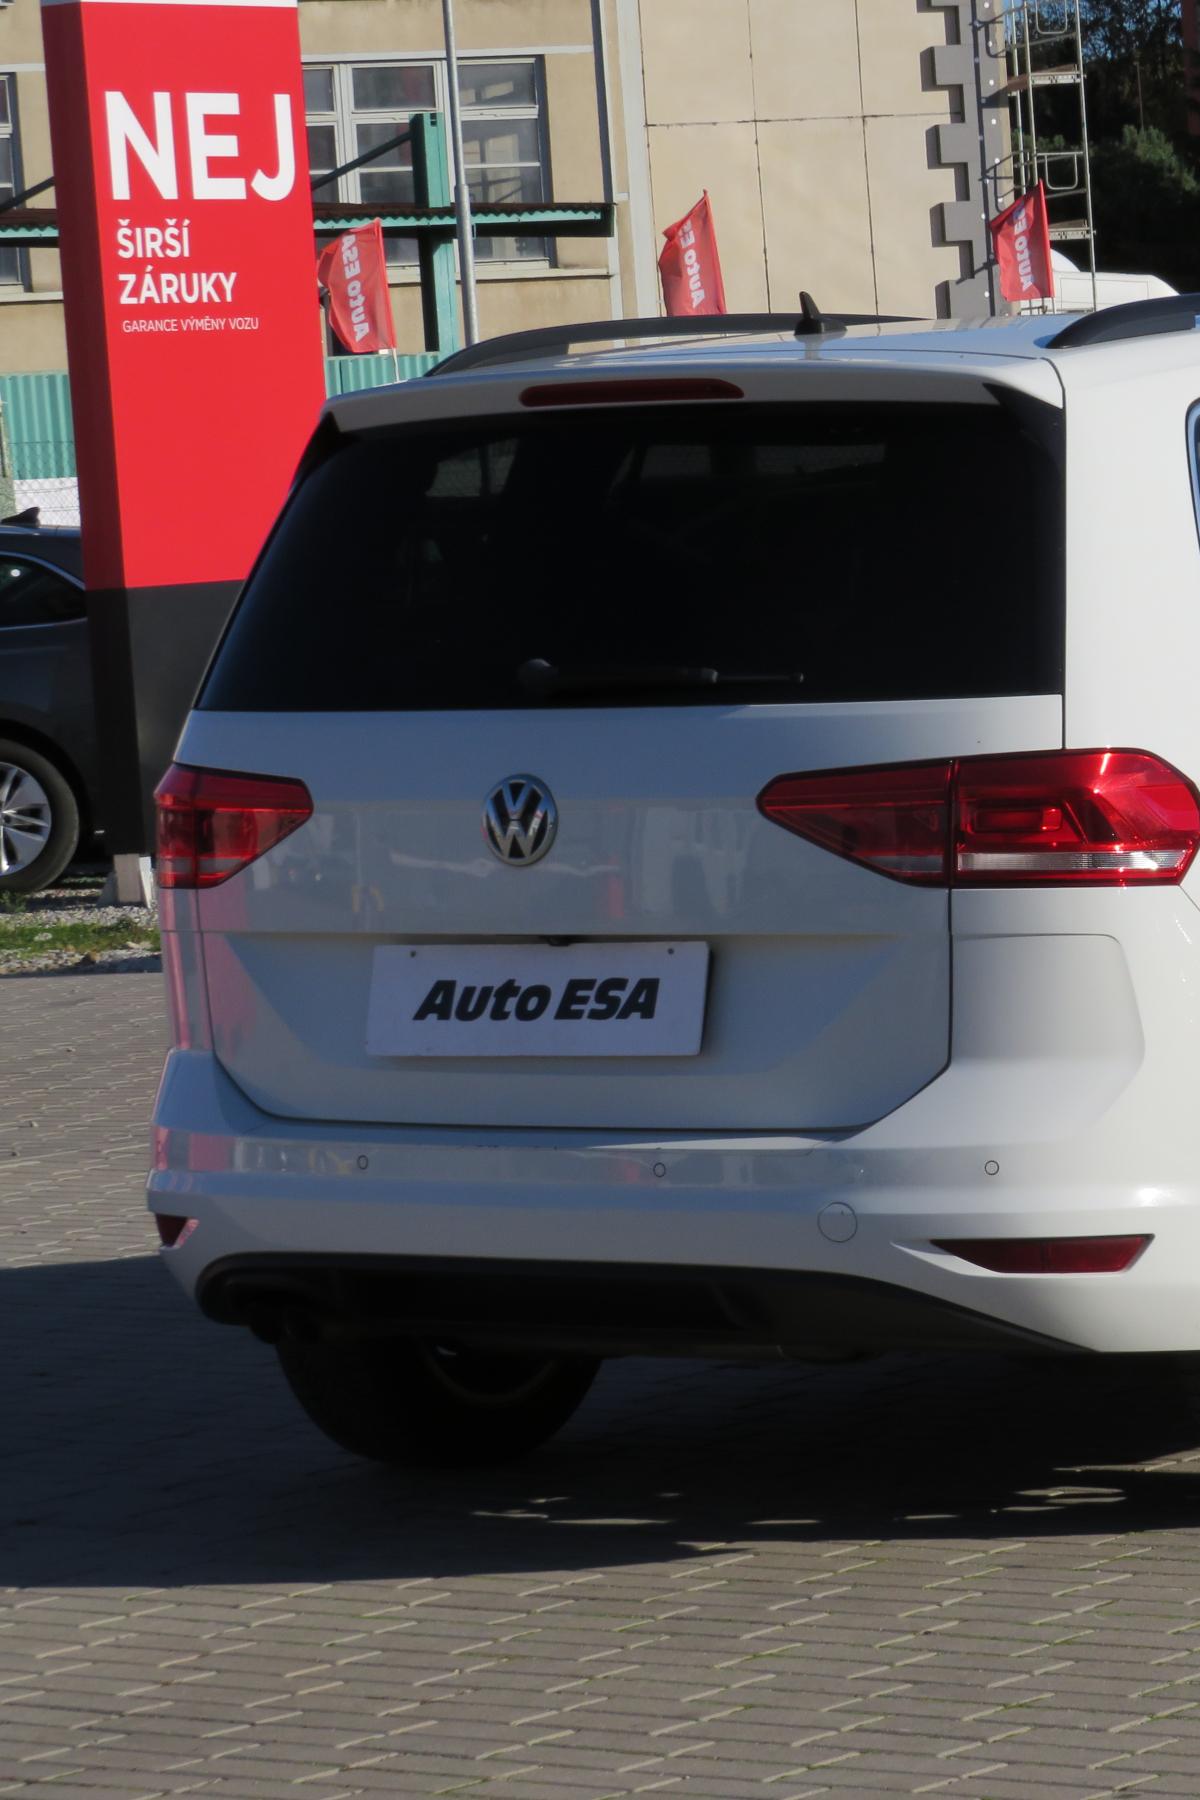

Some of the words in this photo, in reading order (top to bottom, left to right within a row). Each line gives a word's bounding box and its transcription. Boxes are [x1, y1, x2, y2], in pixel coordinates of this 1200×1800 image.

[104, 91, 296, 201] NEJ
[117, 218, 191, 259] ŠIRŠÍ
[118, 265, 237, 304] ZÁRUKY
[122, 320, 178, 333] GARANCE
[180, 316, 226, 331] VÝMĚNY
[229, 317, 259, 330] VOZU
[412, 979, 552, 1022] Auto
[554, 977, 660, 1021] ESA
